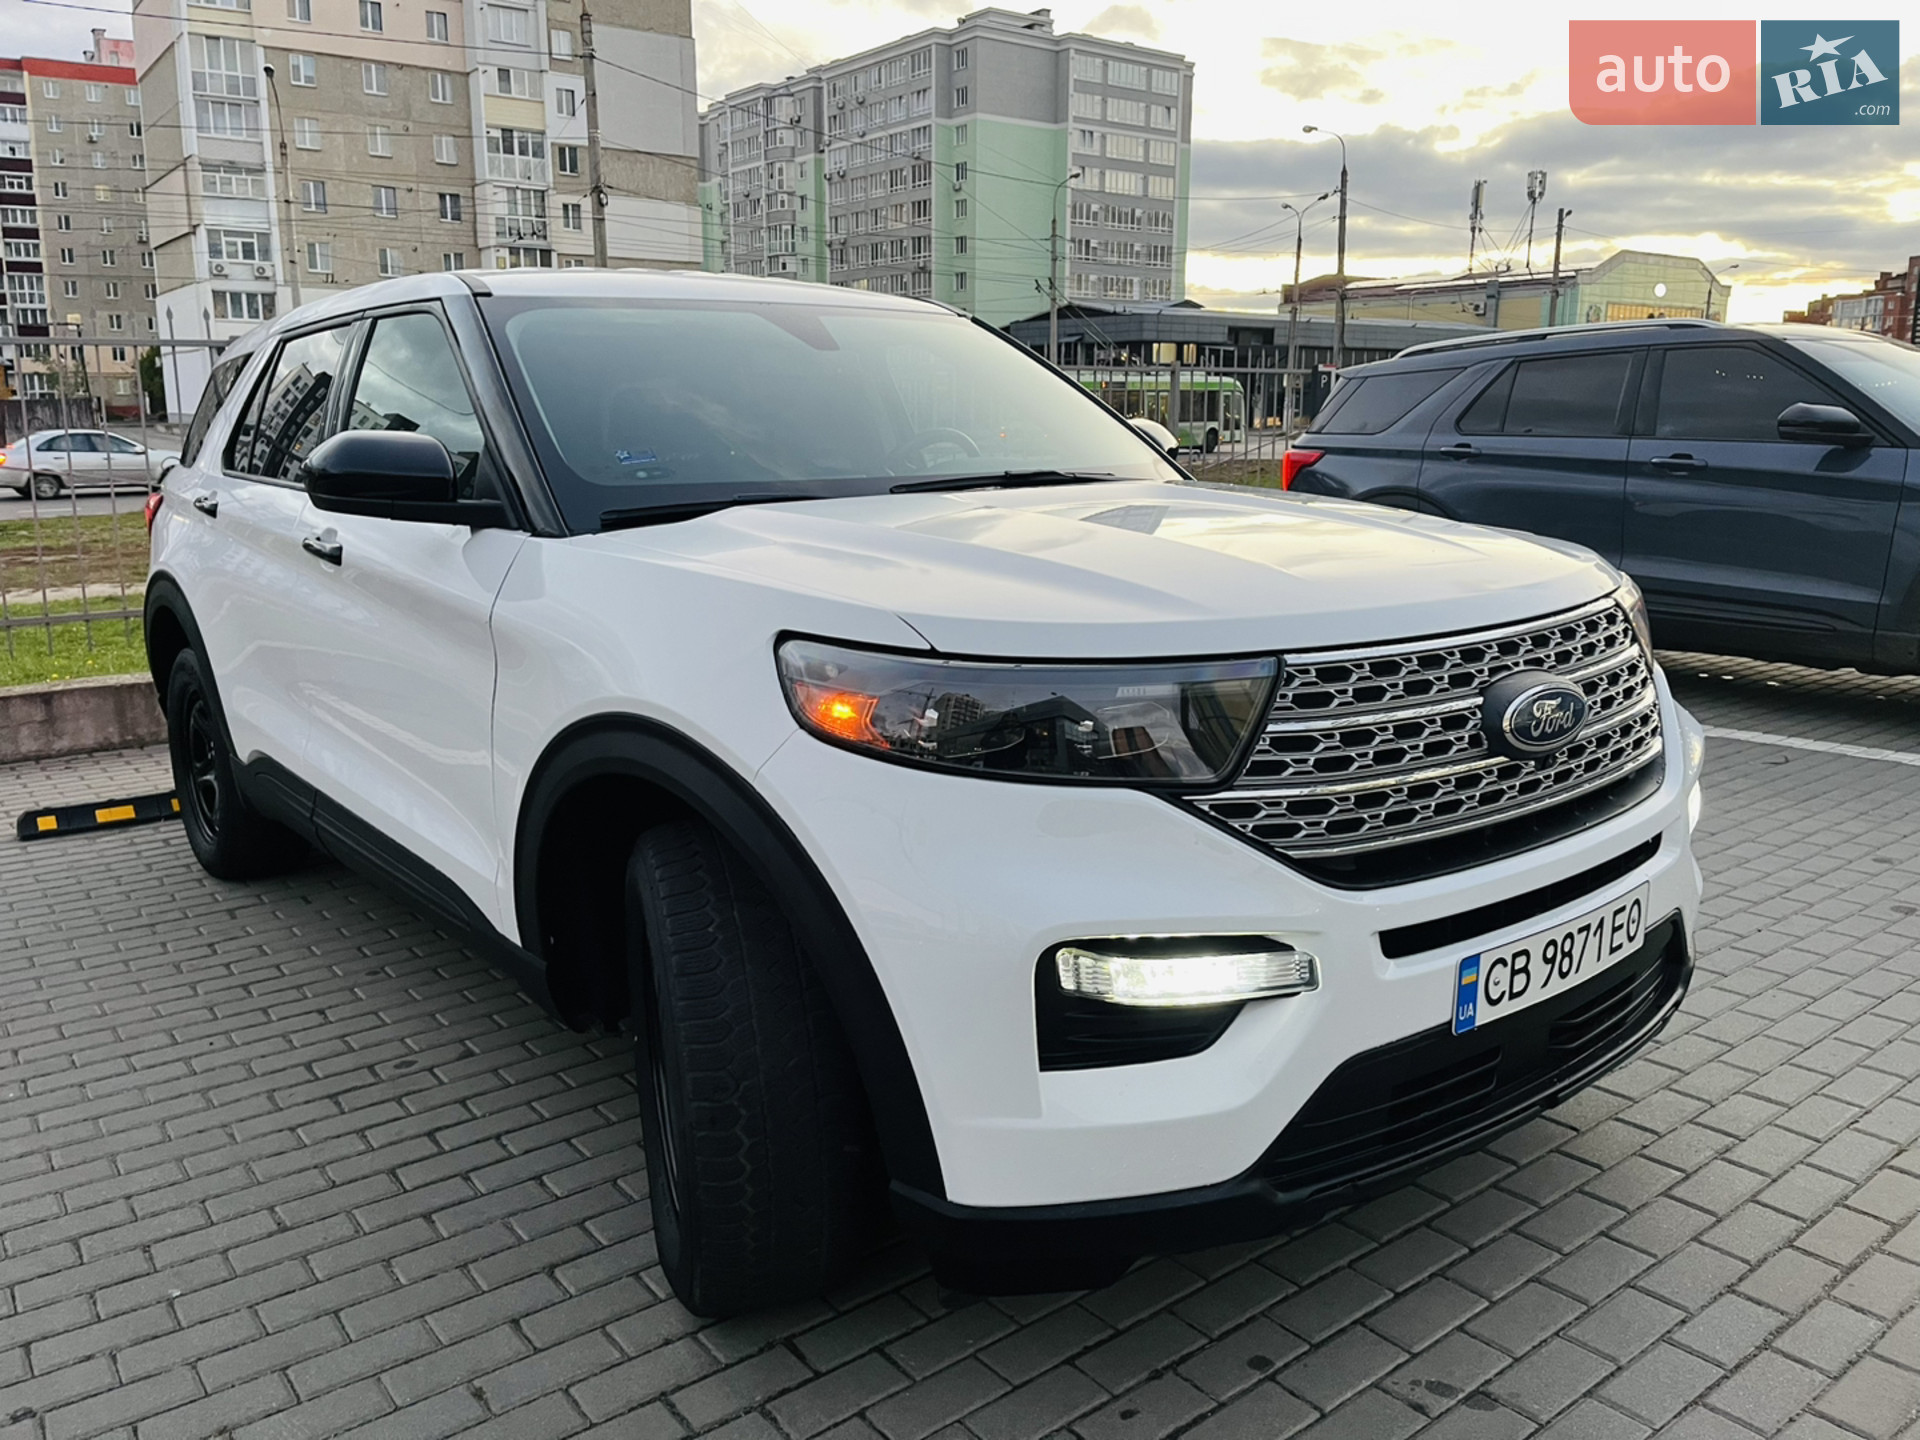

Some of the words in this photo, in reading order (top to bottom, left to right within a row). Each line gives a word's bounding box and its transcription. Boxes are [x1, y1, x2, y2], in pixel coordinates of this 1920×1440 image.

[1321, 374, 1328, 389] P
[1530, 696, 1576, 738] Ford
[1484, 948, 1532, 1007] CB
[1540, 916, 1605, 990] 9871
[1609, 897, 1642, 956] EO
[1458, 1004, 1474, 1021] UA
